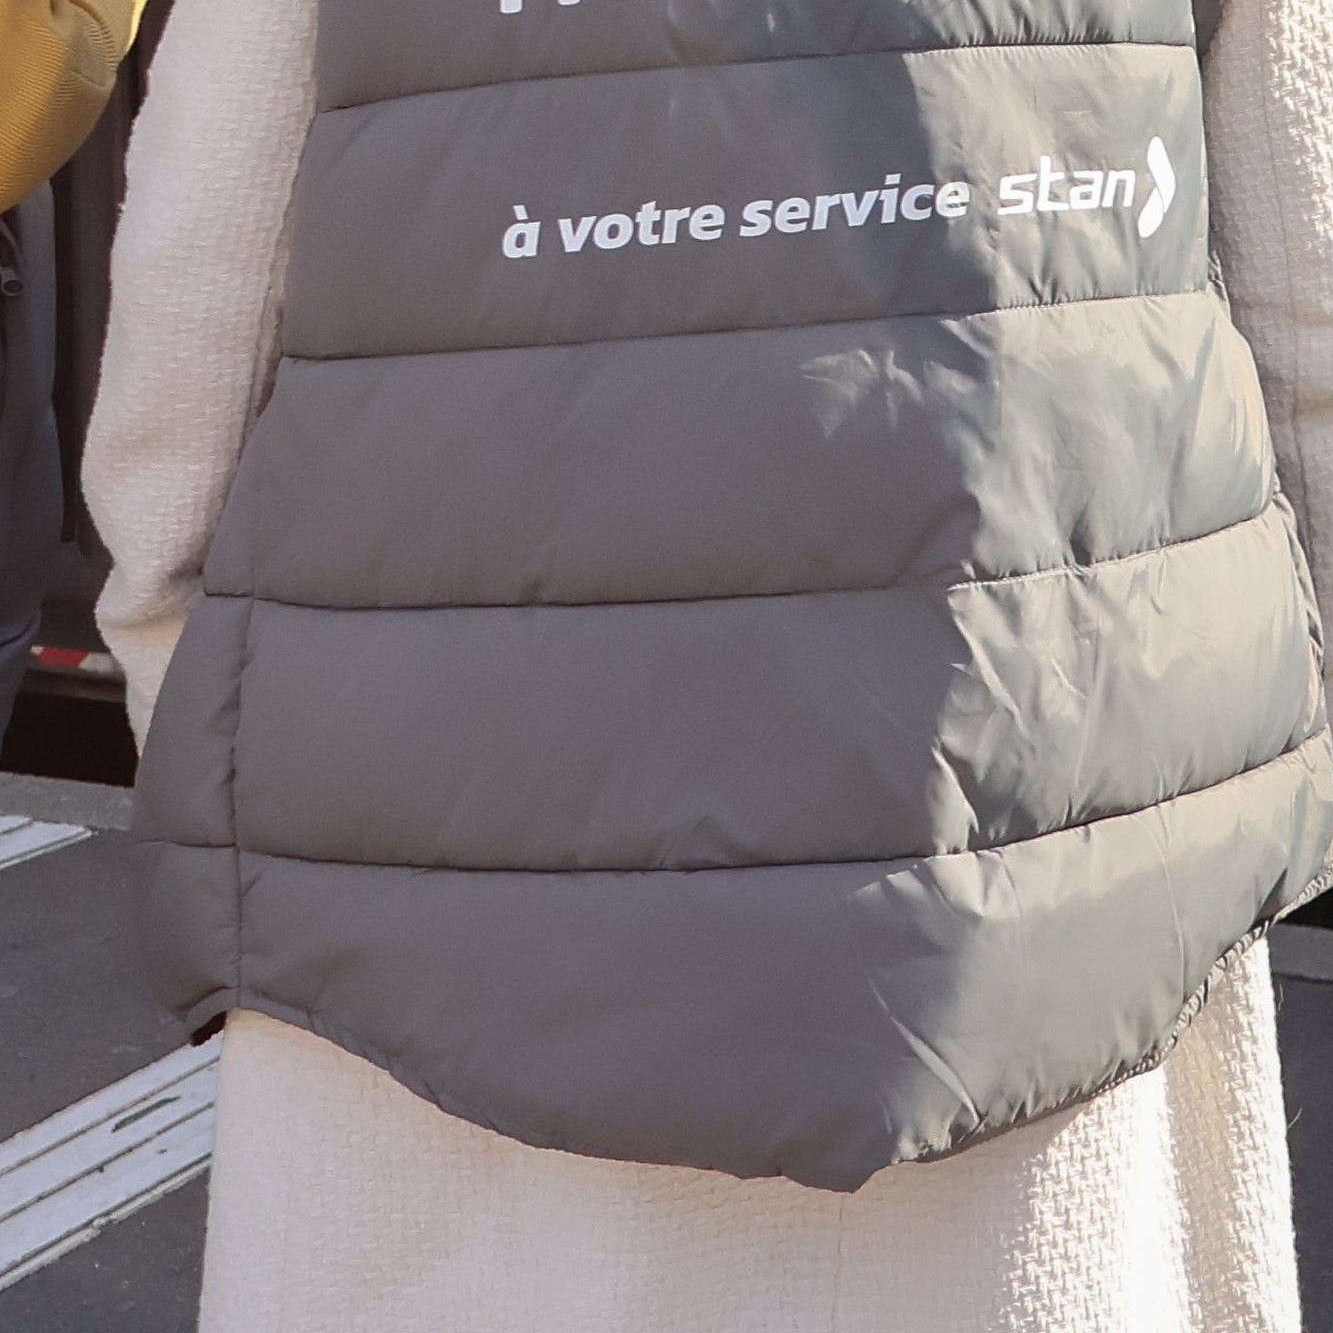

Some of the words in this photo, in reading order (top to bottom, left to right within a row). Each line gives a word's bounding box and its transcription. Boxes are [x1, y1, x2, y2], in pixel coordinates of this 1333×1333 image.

[502, 204, 541, 259] à
[558, 201, 724, 253] votre
[739, 173, 970, 237] service
[997, 156, 1135, 216] stan
